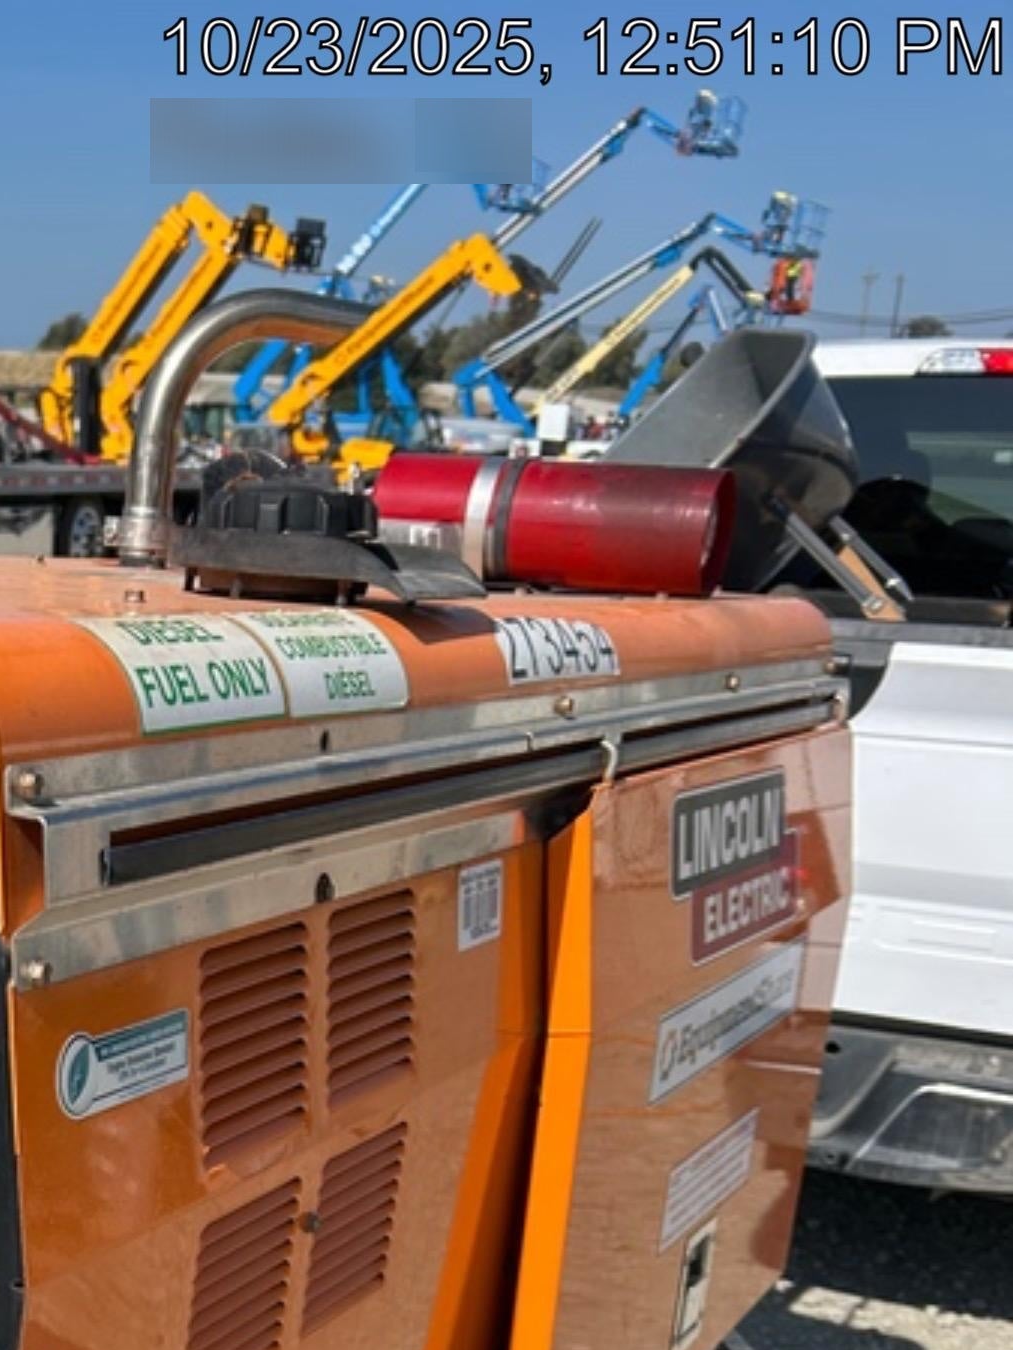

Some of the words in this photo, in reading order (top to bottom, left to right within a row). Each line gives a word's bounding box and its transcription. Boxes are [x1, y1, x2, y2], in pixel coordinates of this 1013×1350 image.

[116, 619, 224, 646] DIESEL
[133, 662, 210, 709] FUEL
[207, 657, 272, 700] ONLY
[678, 789, 782, 881] LINCOLN
[702, 866, 789, 945] ELECTRIC
